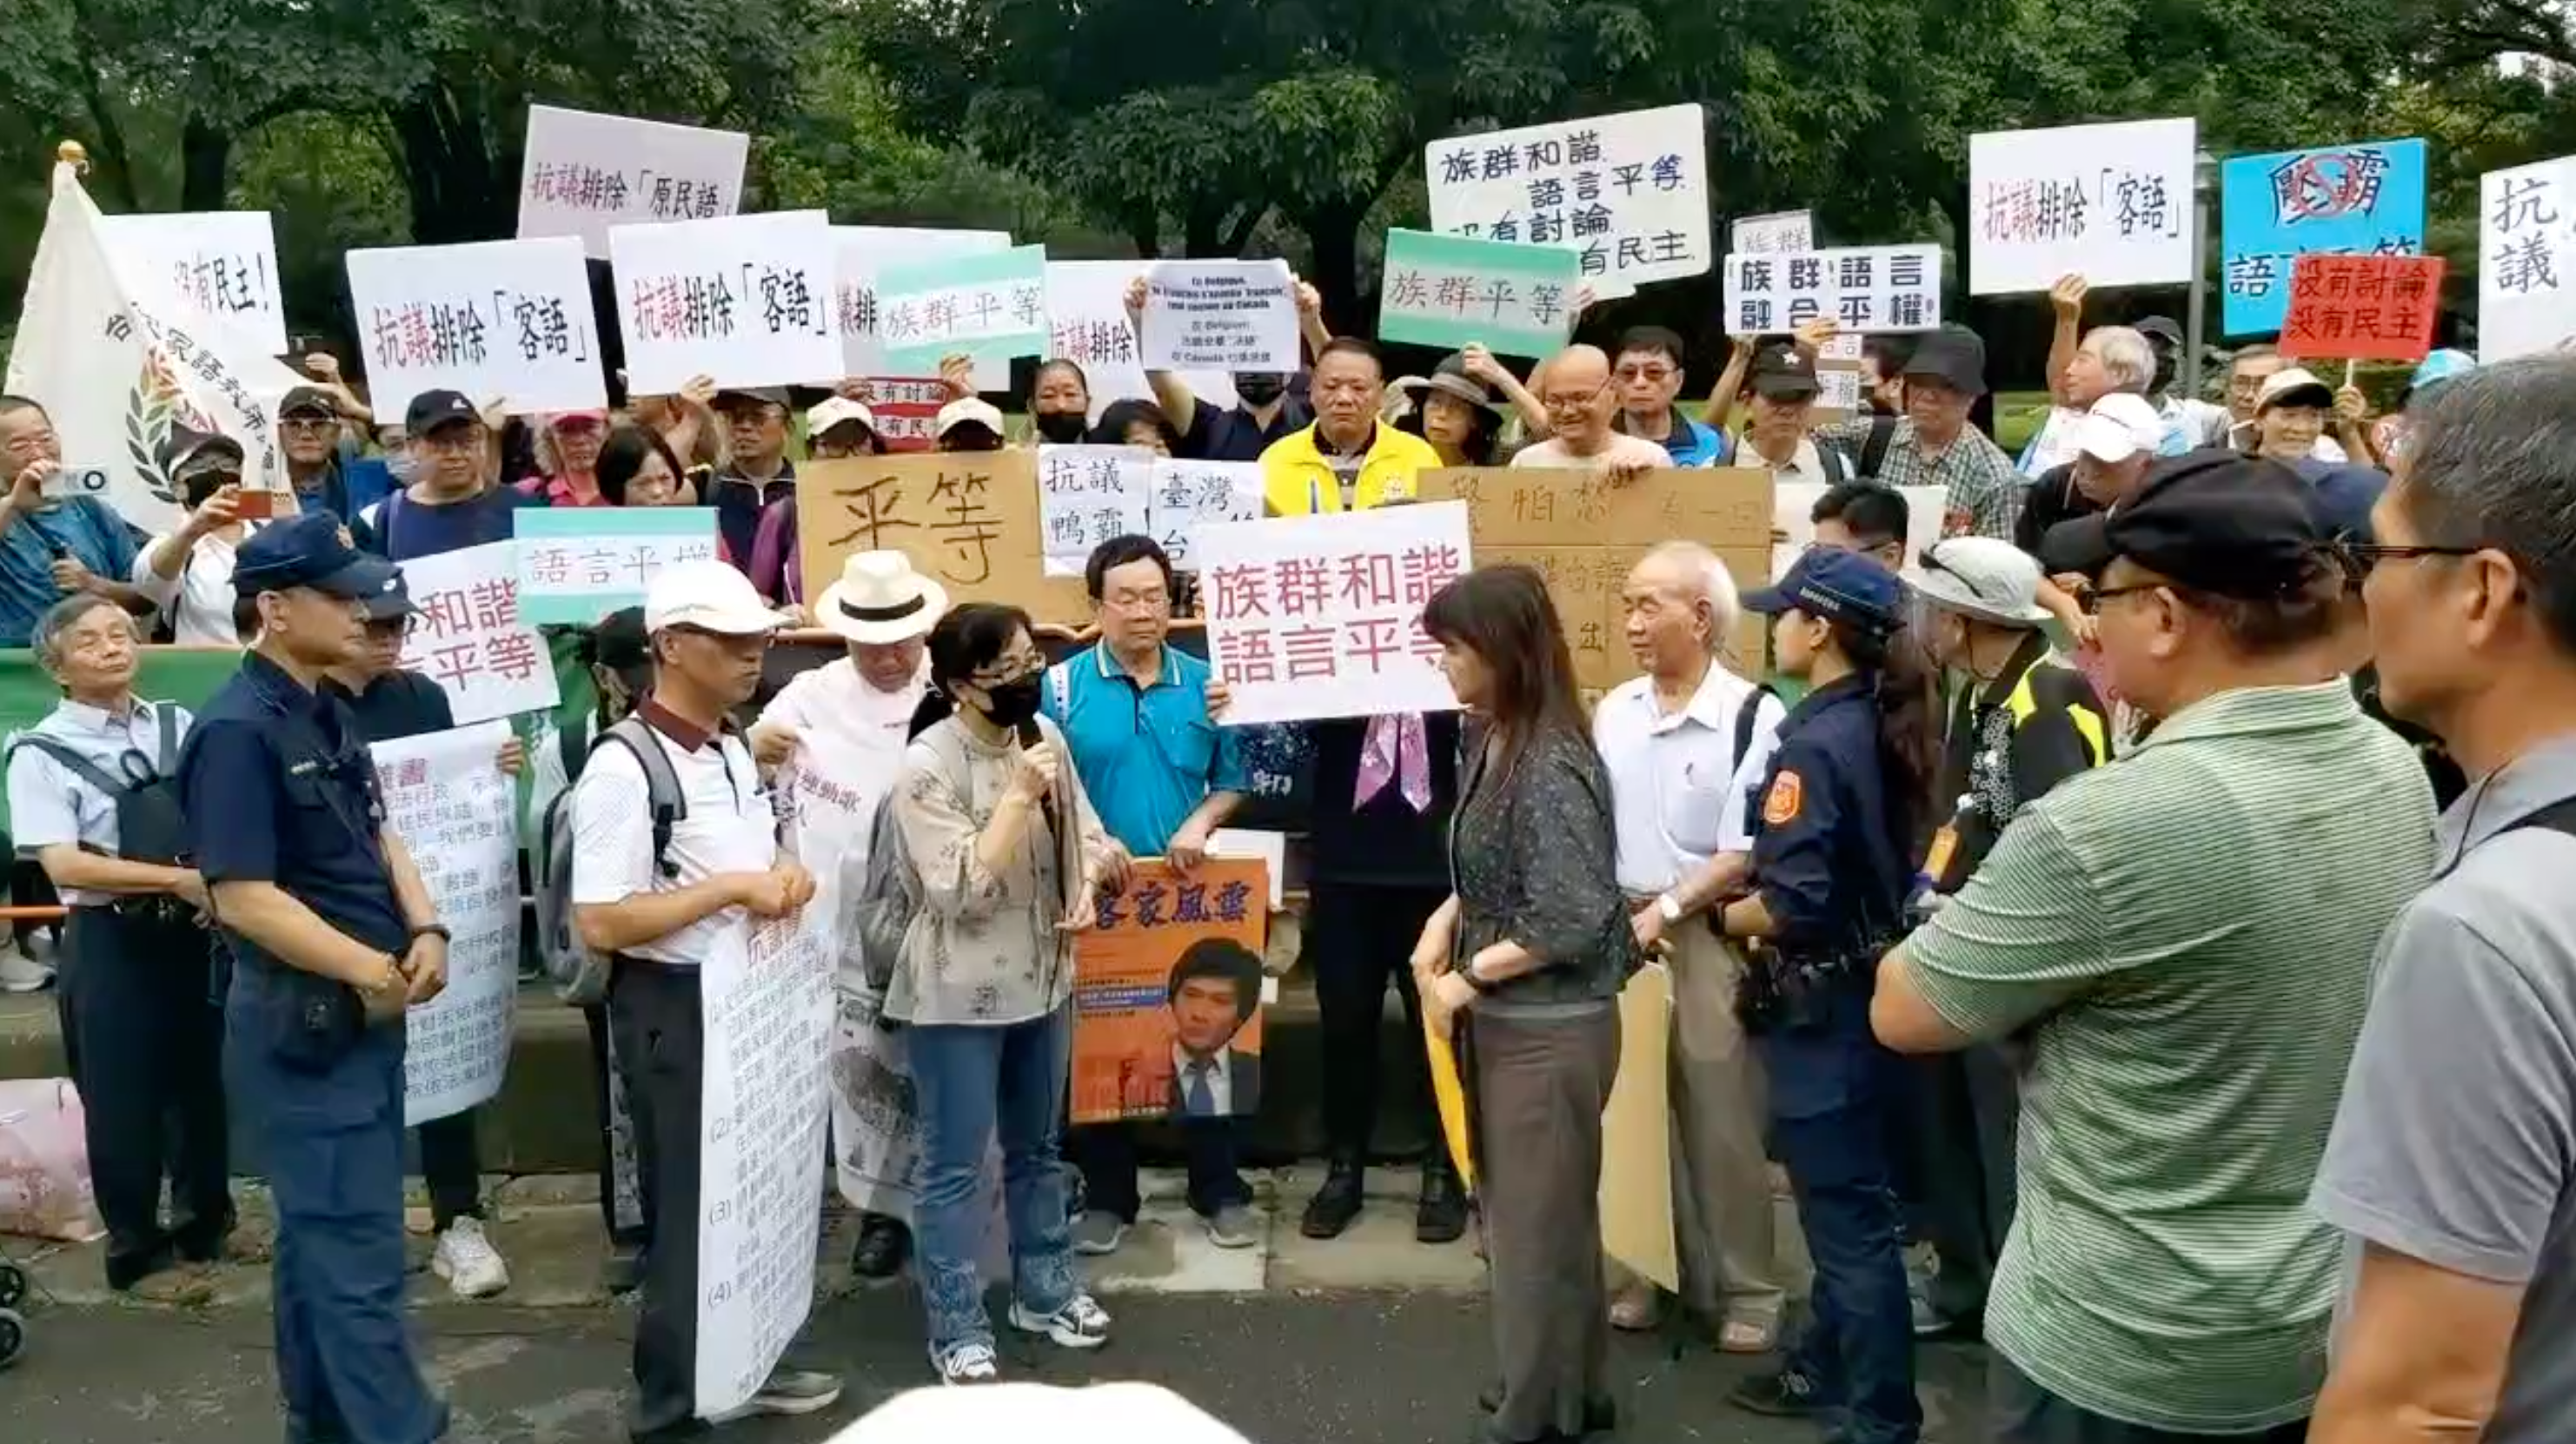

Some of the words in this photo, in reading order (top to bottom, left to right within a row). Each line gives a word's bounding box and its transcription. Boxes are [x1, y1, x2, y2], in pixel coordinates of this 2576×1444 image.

[1986, 168, 2179, 241] 抗議排除「客語」
[2492, 178, 2559, 293] 抗議
[634, 262, 826, 341] 抗議排除「客語」
[1390, 269, 1563, 325] 族群平等
[2295, 260, 2428, 301] 沒有討論
[373, 290, 587, 369] 抗議排除「客語」
[885, 284, 1041, 341] 族群平等
[2287, 307, 2421, 341] 沒有民主
[1046, 458, 1123, 493] 抗議
[1160, 472, 1234, 511] 臺灣
[828, 472, 1005, 585] 平等
[397, 632, 537, 691] 平等
